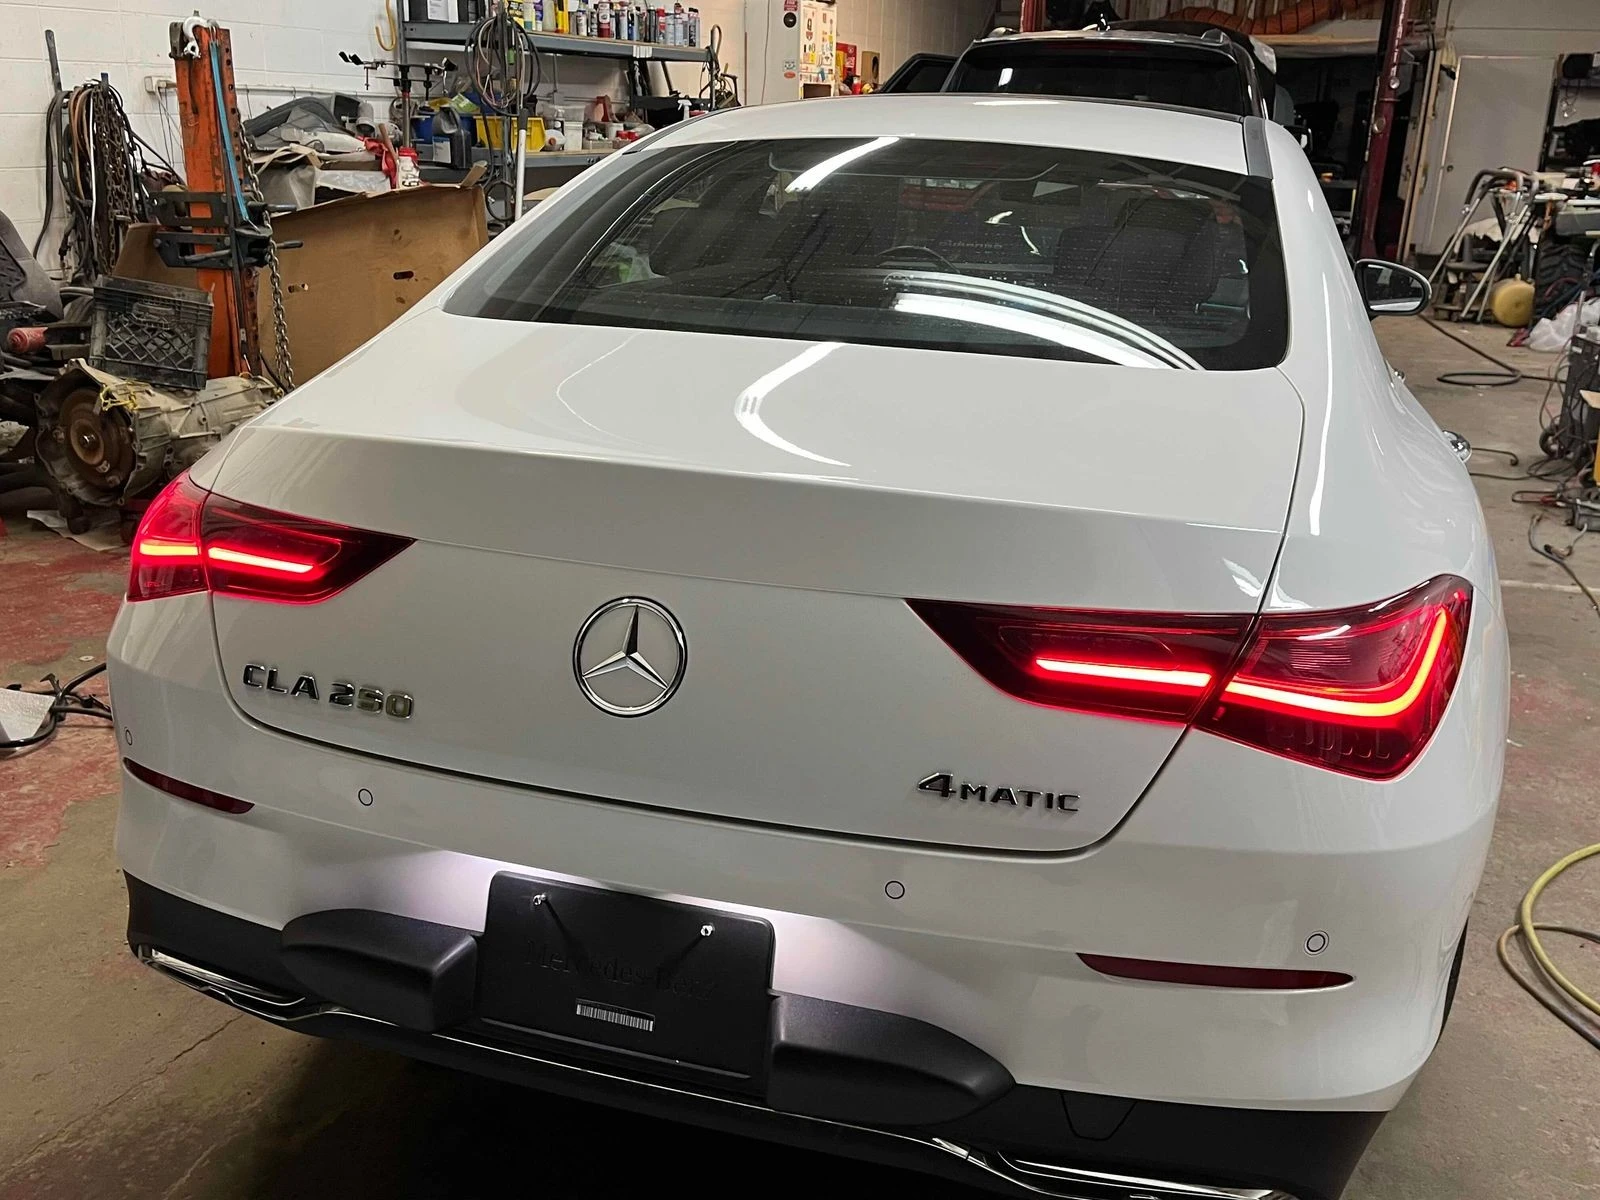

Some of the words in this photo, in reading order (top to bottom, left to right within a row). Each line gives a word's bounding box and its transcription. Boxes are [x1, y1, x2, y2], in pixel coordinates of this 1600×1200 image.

[243, 664, 320, 700] CLA
[328, 682, 415, 719] 250
[918, 772, 1081, 812] 4MATIC
